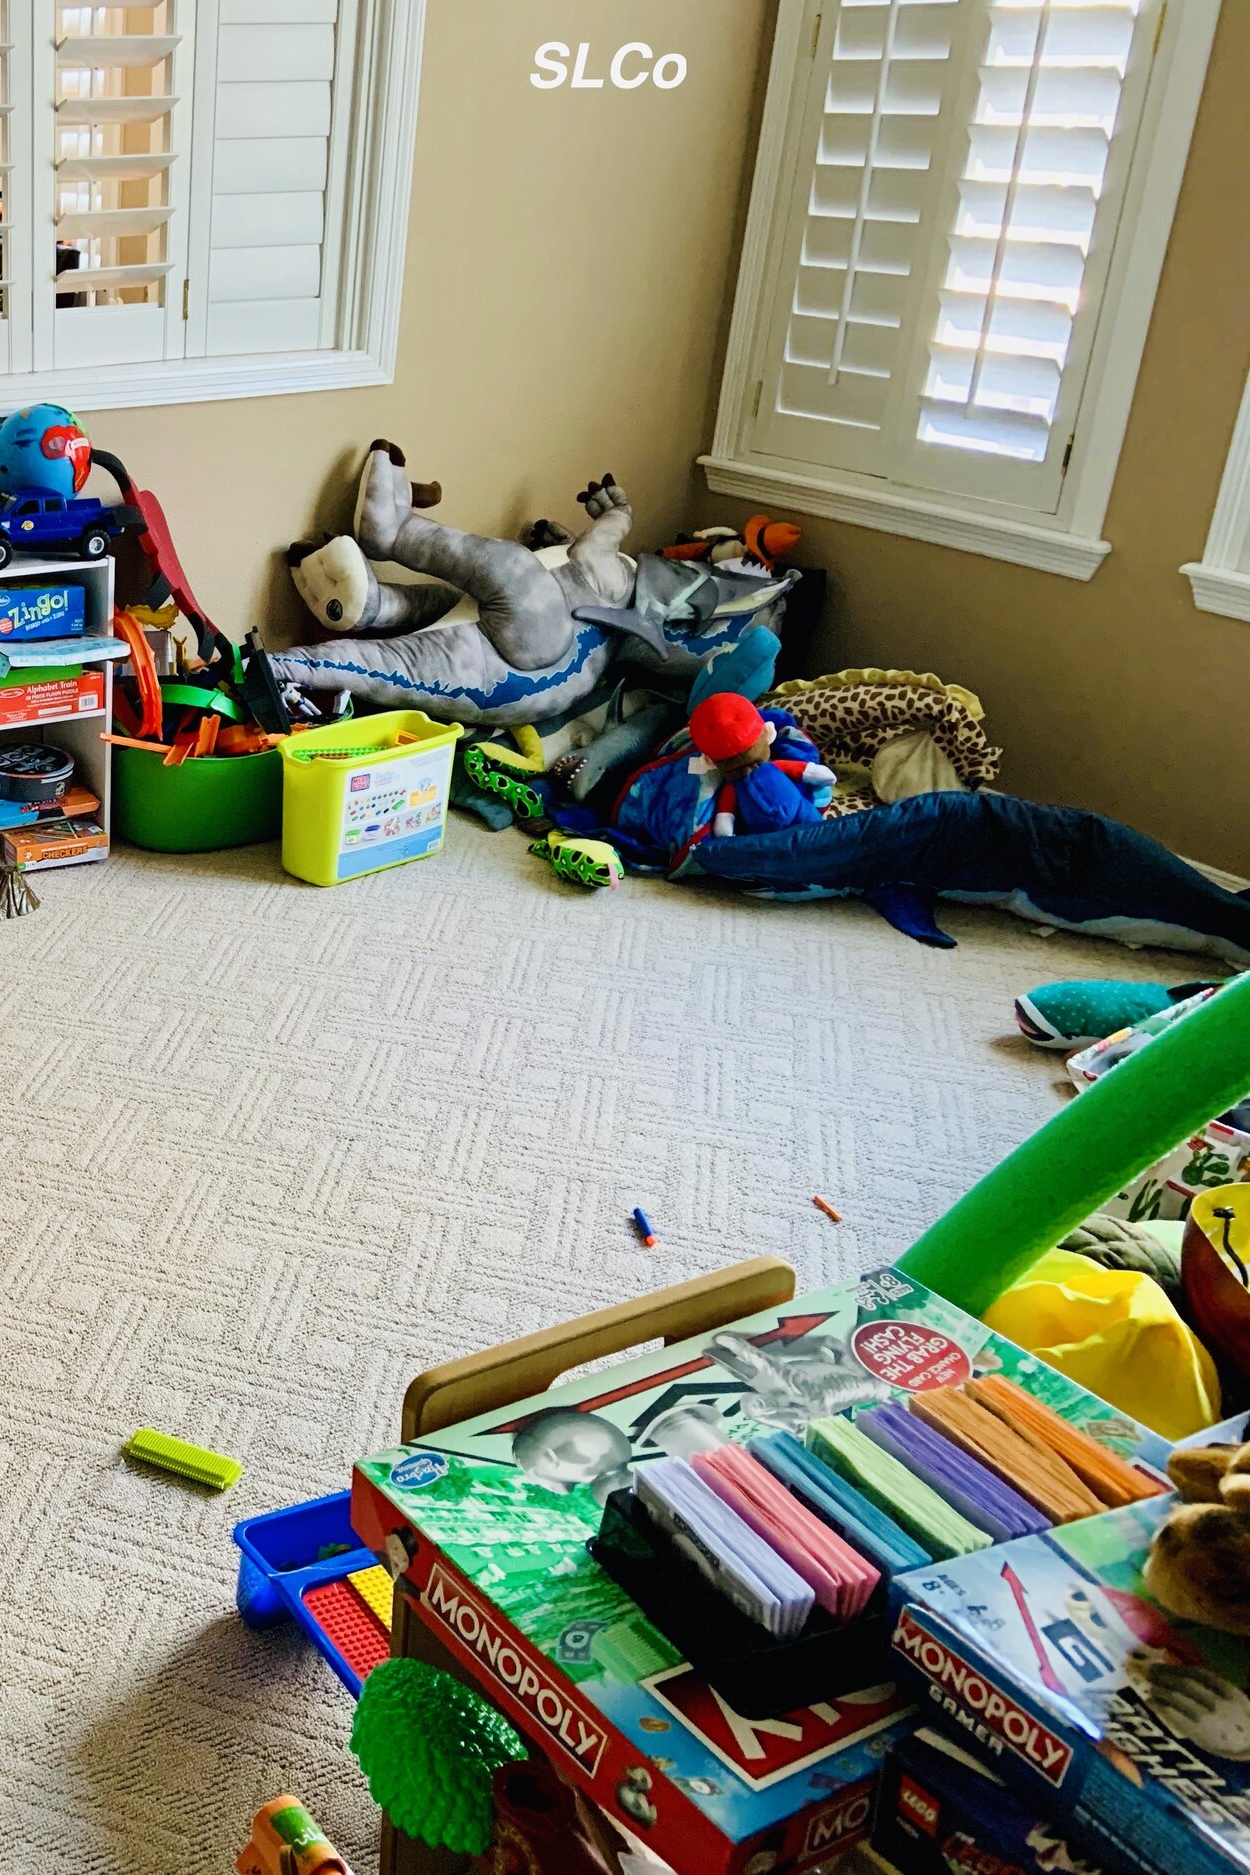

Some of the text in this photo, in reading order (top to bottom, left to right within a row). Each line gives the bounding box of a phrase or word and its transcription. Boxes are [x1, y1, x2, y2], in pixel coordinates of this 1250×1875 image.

[7, 590, 69, 629] Zingo!
[26, 680, 77, 694] Alphabet Train
[42, 845, 89, 860] CHECKERS
[860, 1325, 905, 1354] CASH!
[873, 1331, 925, 1365] FLYING
[879, 1337, 948, 1381] GRAB THE
[927, 1352, 962, 1375] CHANCE
[936, 1368, 957, 1384] NEW
[396, 1454, 447, 1484] Hasbro
[432, 1579, 599, 1757] MONOPOLY
[893, 1626, 1065, 1769] MONOPOLY
[928, 1684, 1004, 1756] GAMER
[901, 1789, 938, 1823] LEGO
